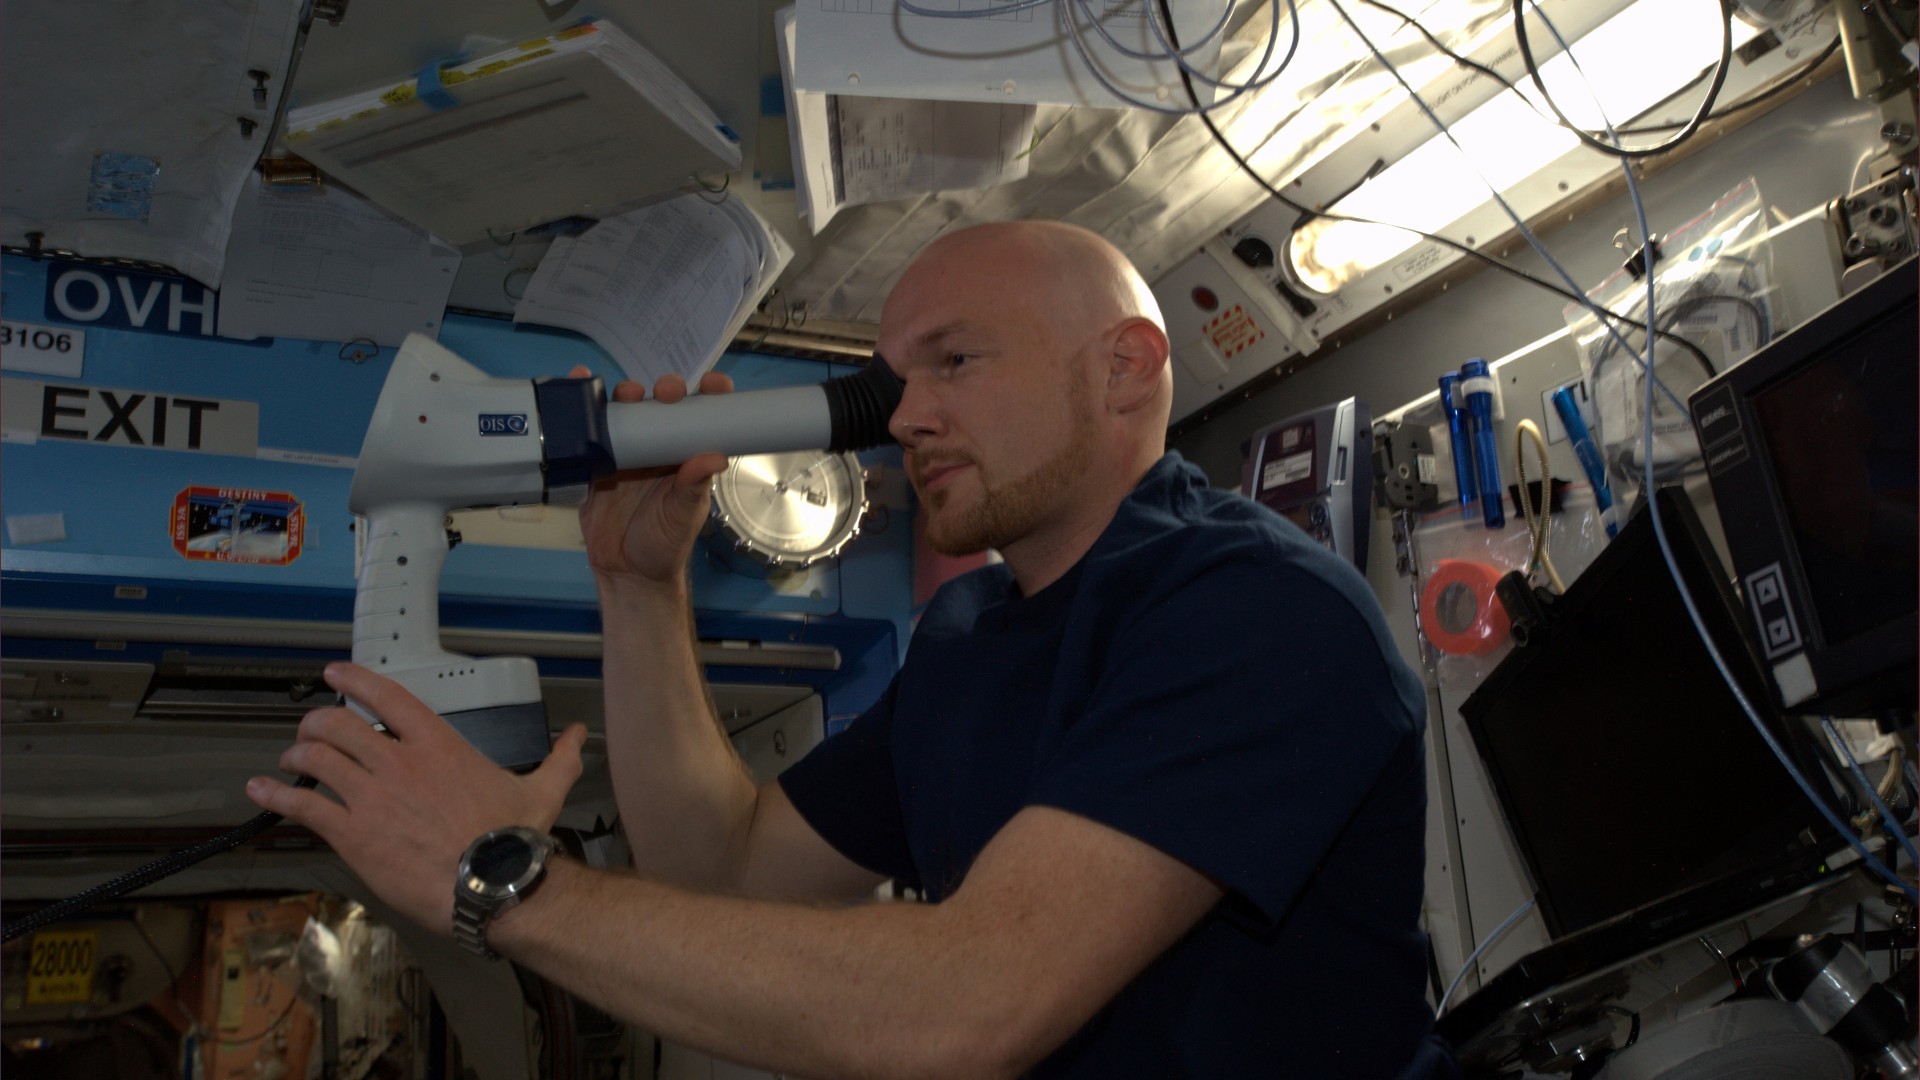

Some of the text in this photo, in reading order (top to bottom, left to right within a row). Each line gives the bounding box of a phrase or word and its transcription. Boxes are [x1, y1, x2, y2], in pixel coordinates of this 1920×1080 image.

[41, 385, 220, 450] EXIT
[480, 417, 505, 431] OIS
[218, 488, 267, 501] DESTINY
[32, 938, 93, 977] 28000
